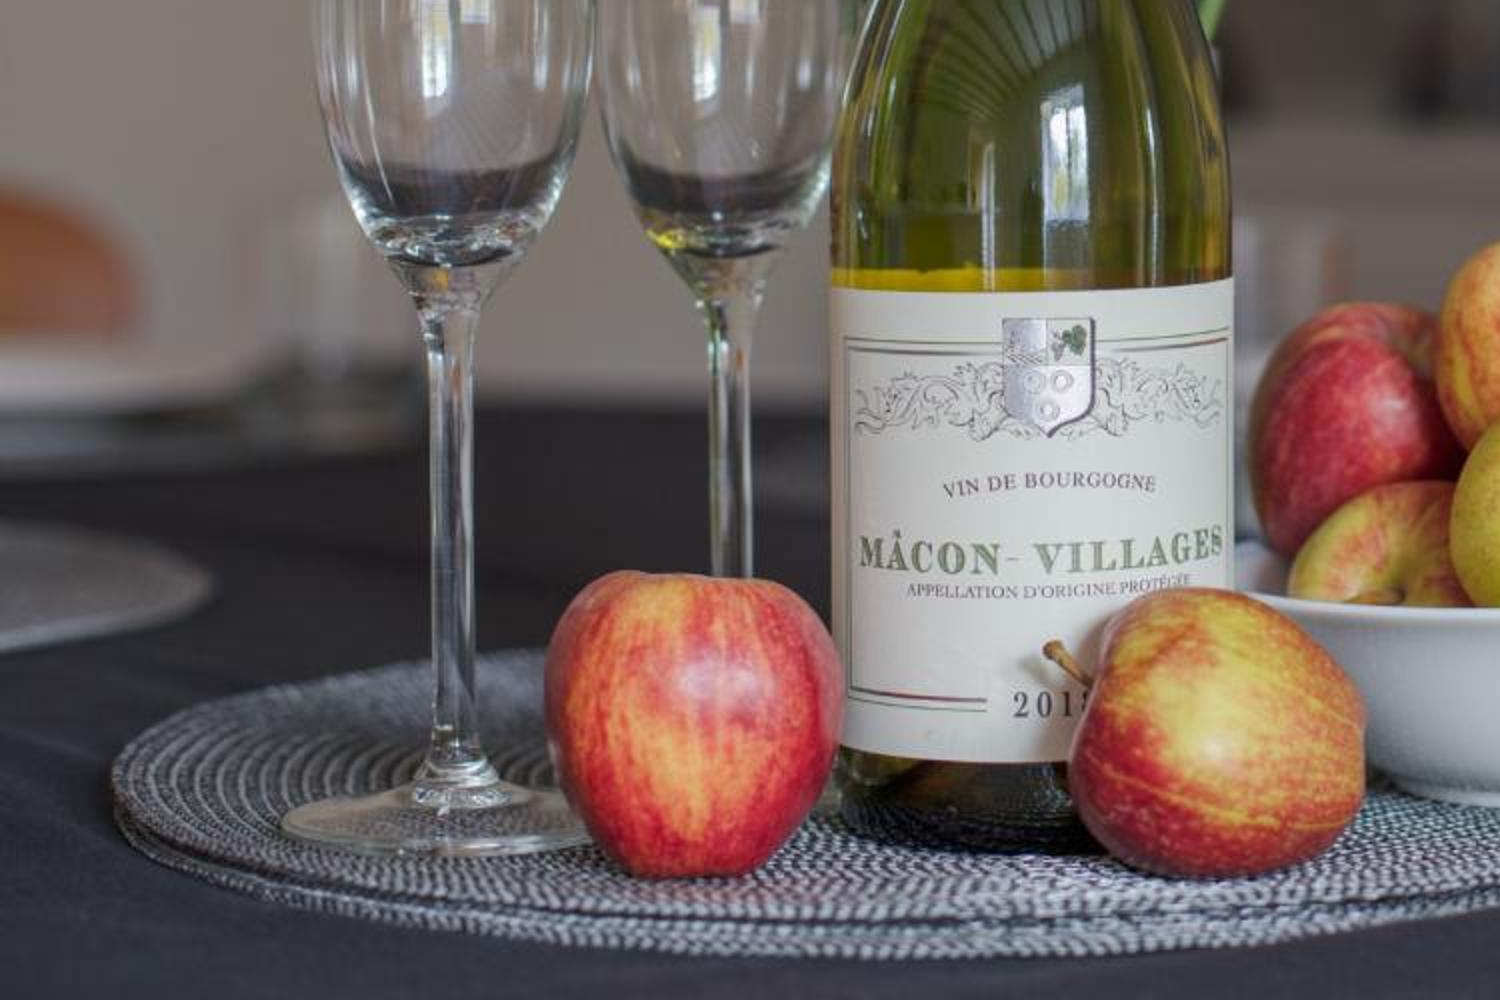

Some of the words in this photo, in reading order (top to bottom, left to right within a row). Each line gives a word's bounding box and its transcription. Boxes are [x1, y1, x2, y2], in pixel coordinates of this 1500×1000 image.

[942, 478, 980, 498] VIN
[986, 474, 1017, 493] DE
[1024, 471, 1157, 493] BOURGOGNE
[1033, 524, 1224, 575] VILLAGES
[906, 583, 1019, 599] APPELLATION
[1023, 582, 1116, 599] D'ORIGINE
